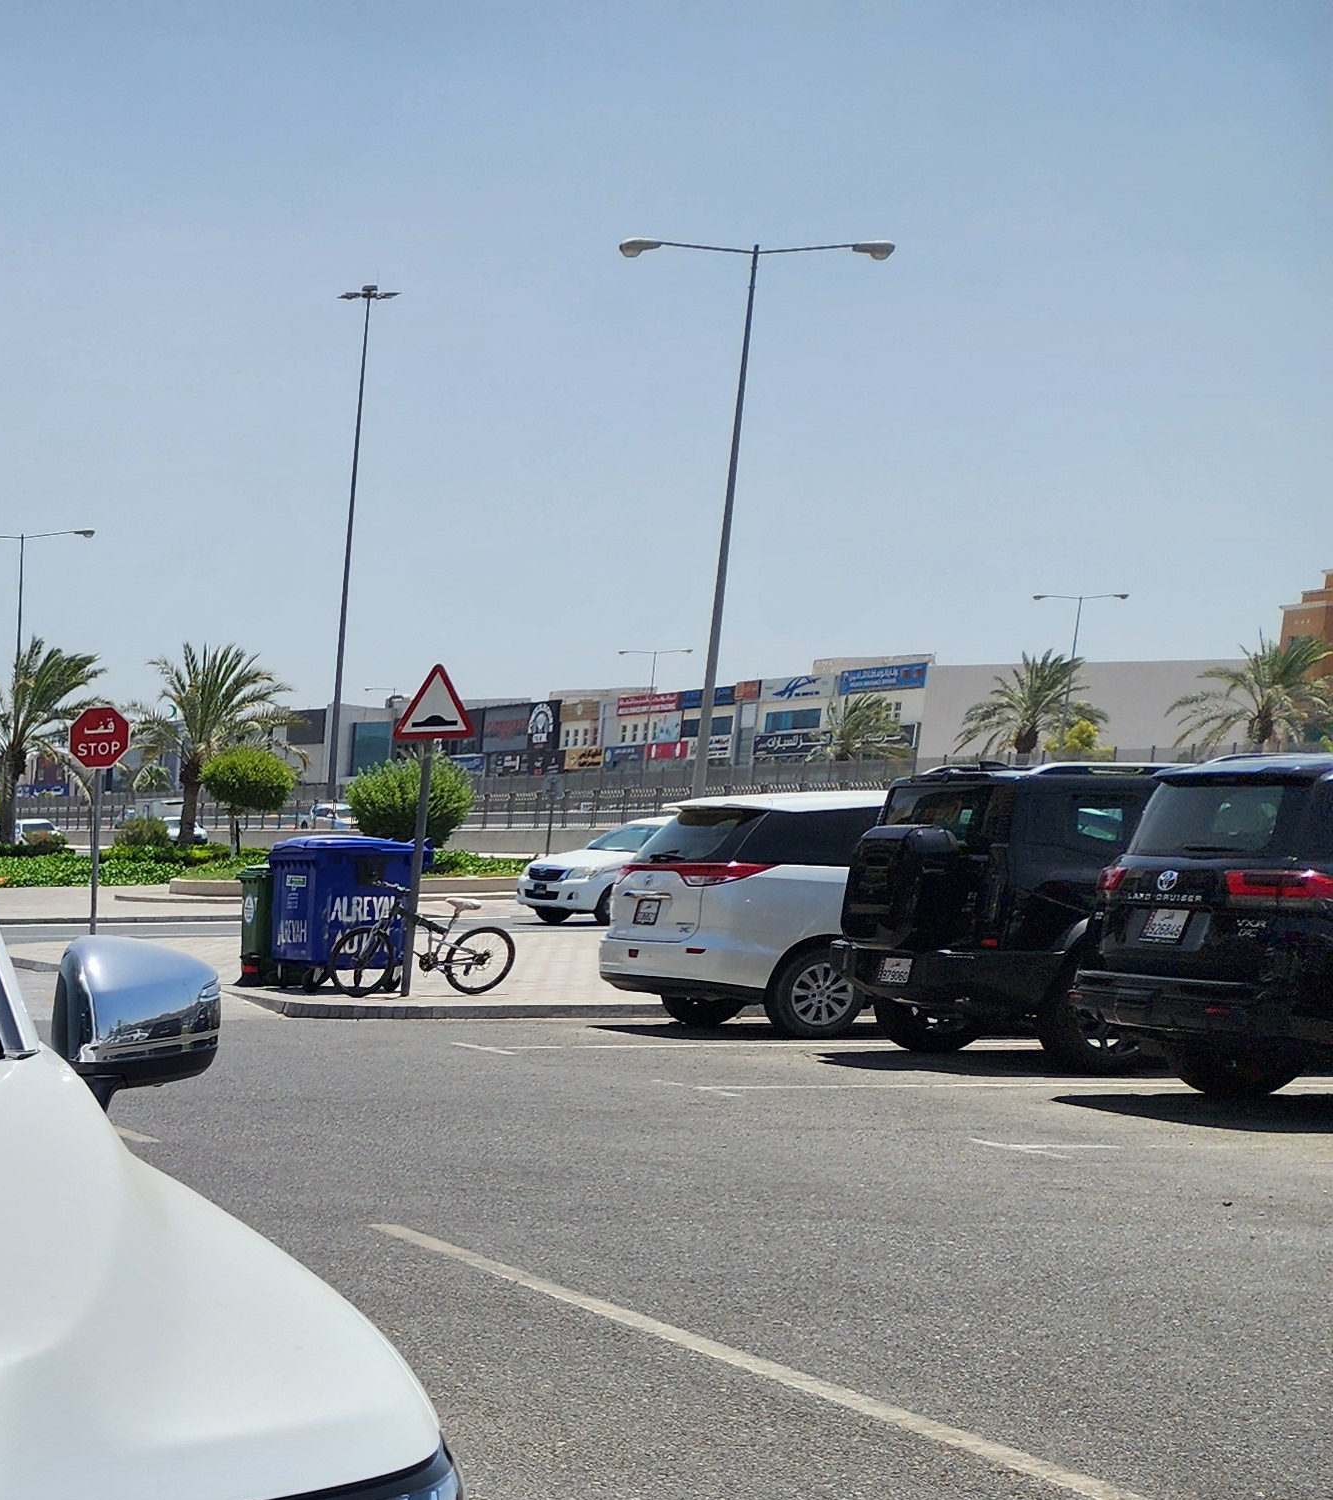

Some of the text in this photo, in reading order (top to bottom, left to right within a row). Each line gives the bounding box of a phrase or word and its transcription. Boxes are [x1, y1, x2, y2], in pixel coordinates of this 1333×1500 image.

[84, 716, 116, 735] قف
[77, 741, 121, 757] STOP
[1156, 893, 1202, 902] CRUISER
